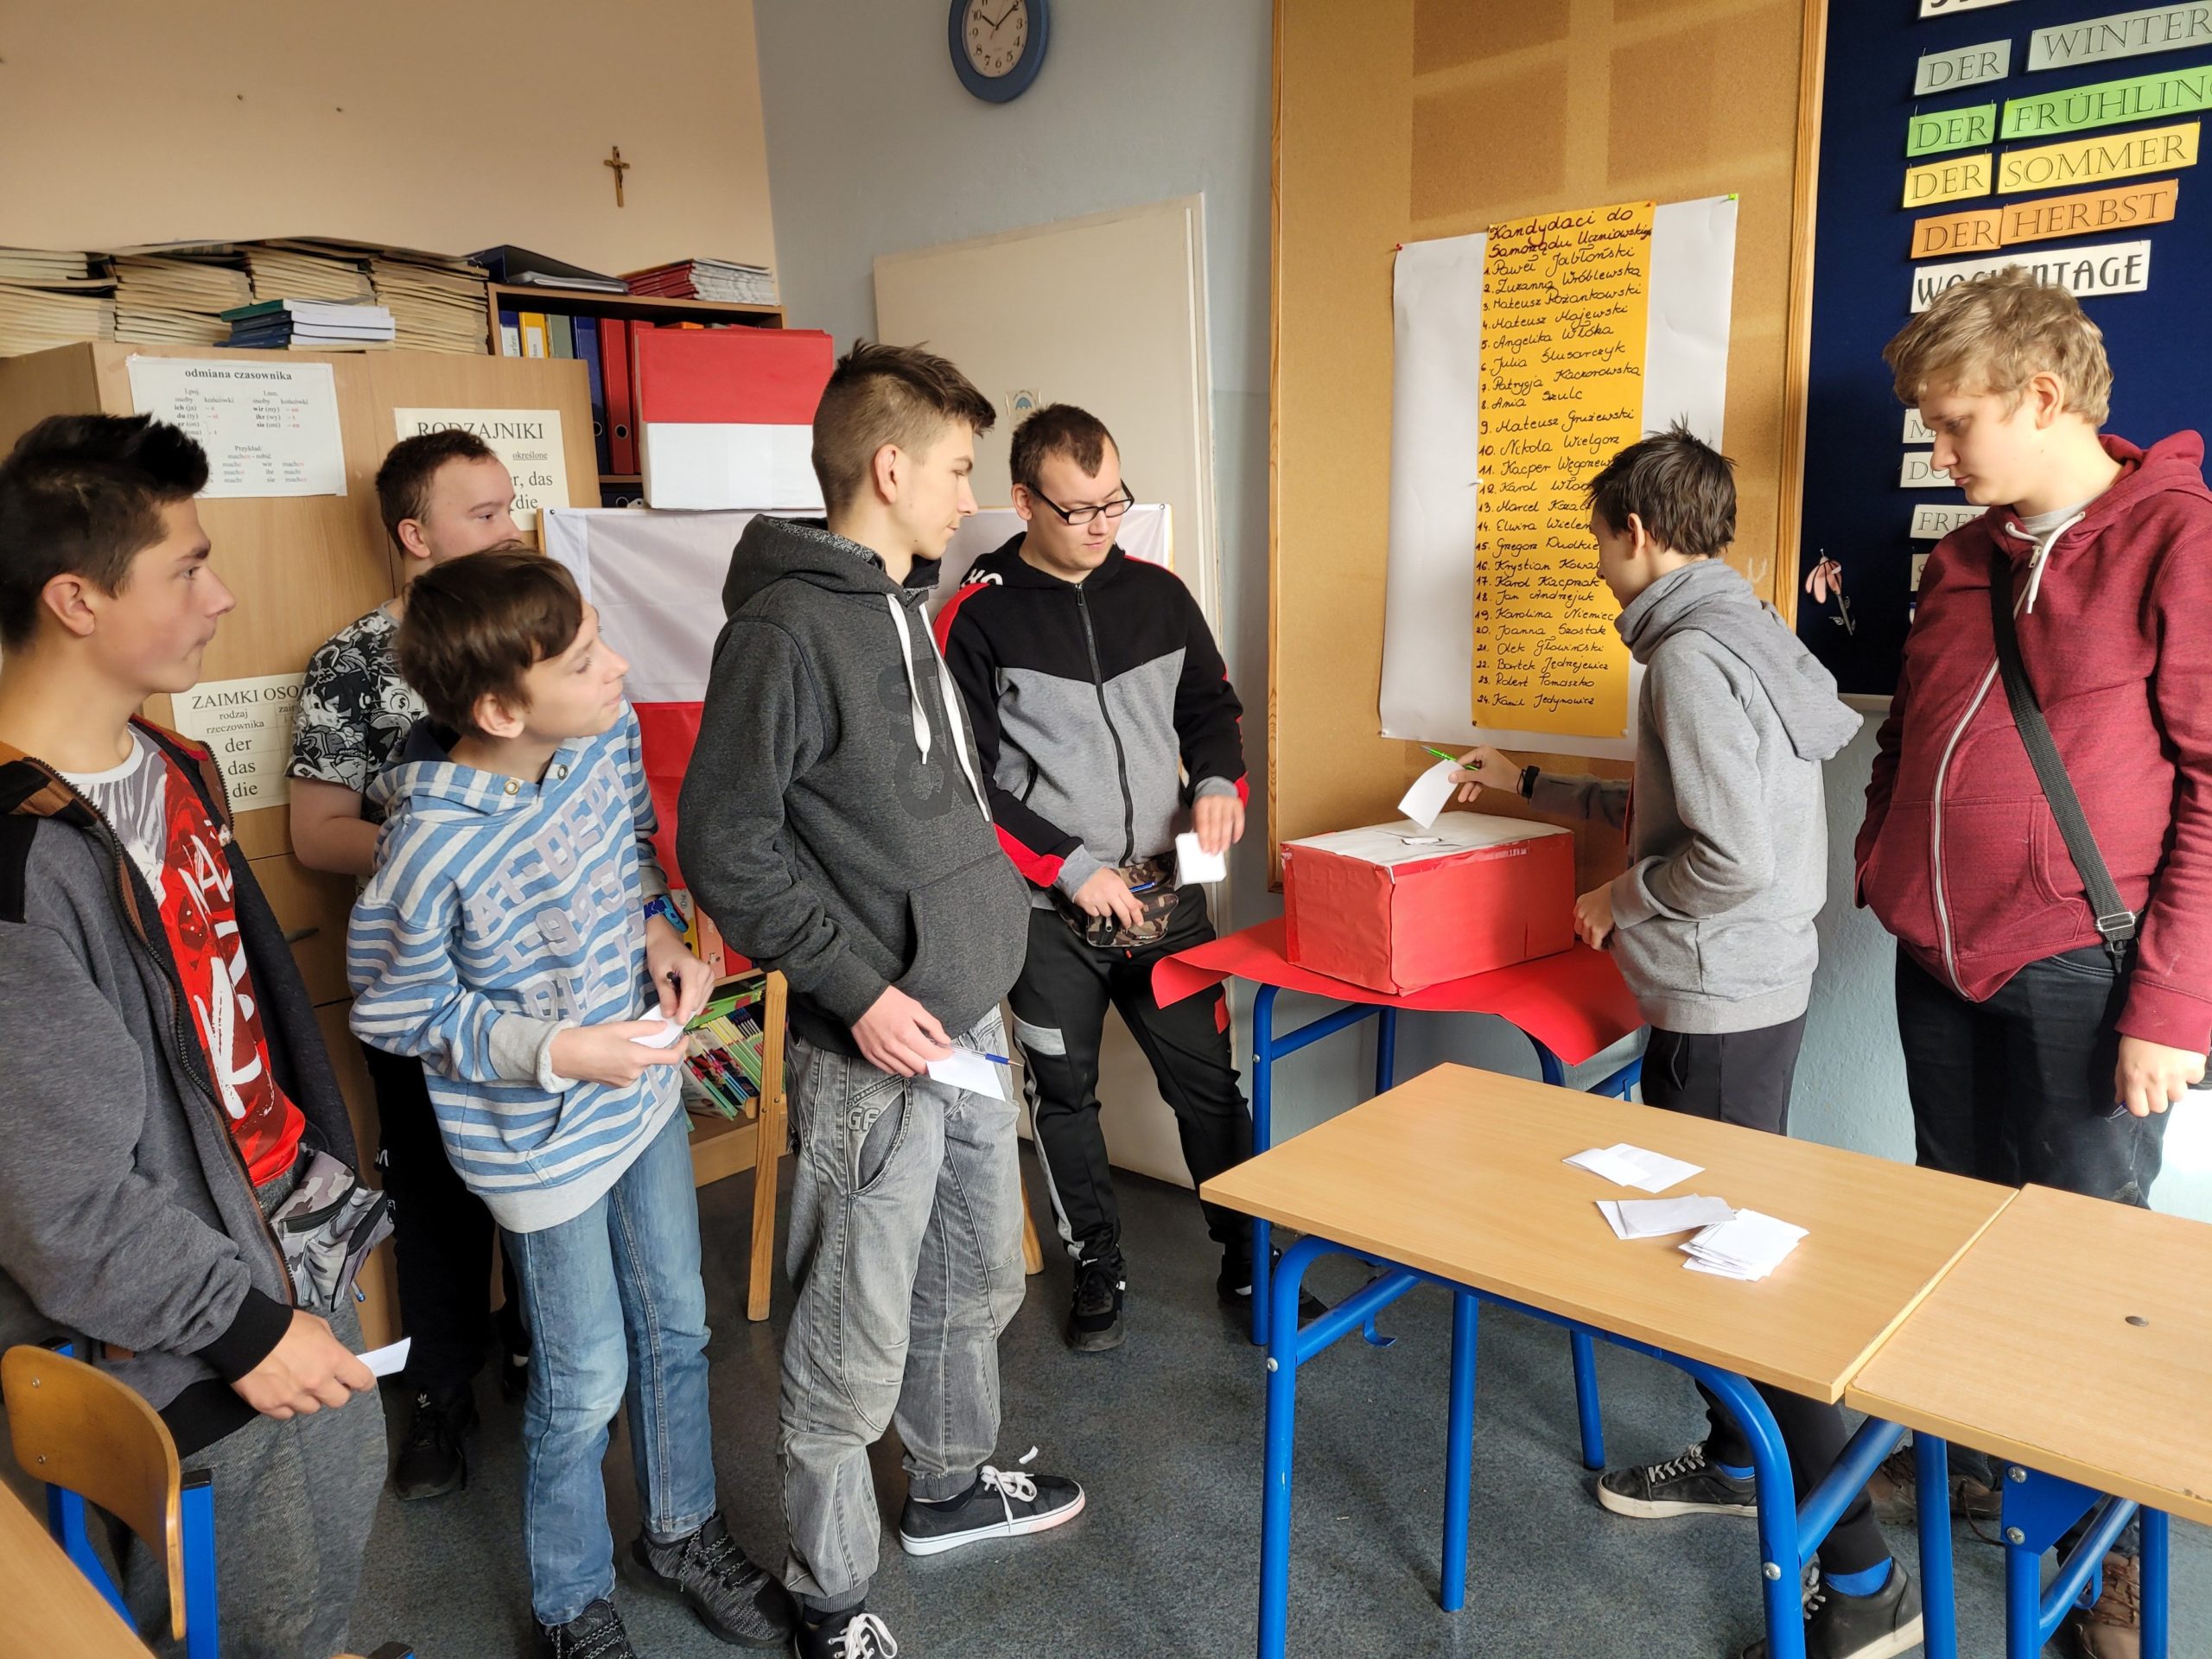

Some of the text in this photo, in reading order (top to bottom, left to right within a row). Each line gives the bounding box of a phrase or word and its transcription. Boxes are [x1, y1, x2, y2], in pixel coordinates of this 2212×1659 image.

[973, 10, 982, 21] 10
[1016, 18, 1022, 29] 3
[972, 28, 978, 36] 9
[1014, 36, 1020, 47] 4
[1927, 7, 2212, 87] DER WINTER
[976, 44, 982, 55] 8
[985, 55, 990, 66] 7
[995, 57, 1001, 68] 6
[1007, 52, 1013, 62] 5
[1914, 75, 2212, 149] DER FRÜHLIN
[1910, 134, 2187, 200] DER SOMMER
[1489, 207, 1633, 246] Kandydaci do
[1922, 191, 2168, 252] DER HERBST
[1917, 254, 2143, 306] WNTAGE
[185, 368, 292, 380] odmiana czasownika
[512, 451, 548, 461] określone
[1558, 455, 1613, 476] Węgorzew
[529, 471, 553, 486] das
[516, 494, 538, 510] die
[1546, 536, 1599, 550] Dudkie
[1559, 558, 1600, 569] Kowal
[192, 685, 299, 709] ZAIMKI OSO
[219, 709, 248, 720] rodzaj
[207, 721, 264, 734] rzeczownika
[225, 738, 252, 753] der
[227, 760, 256, 776] das
[232, 782, 258, 798] die
